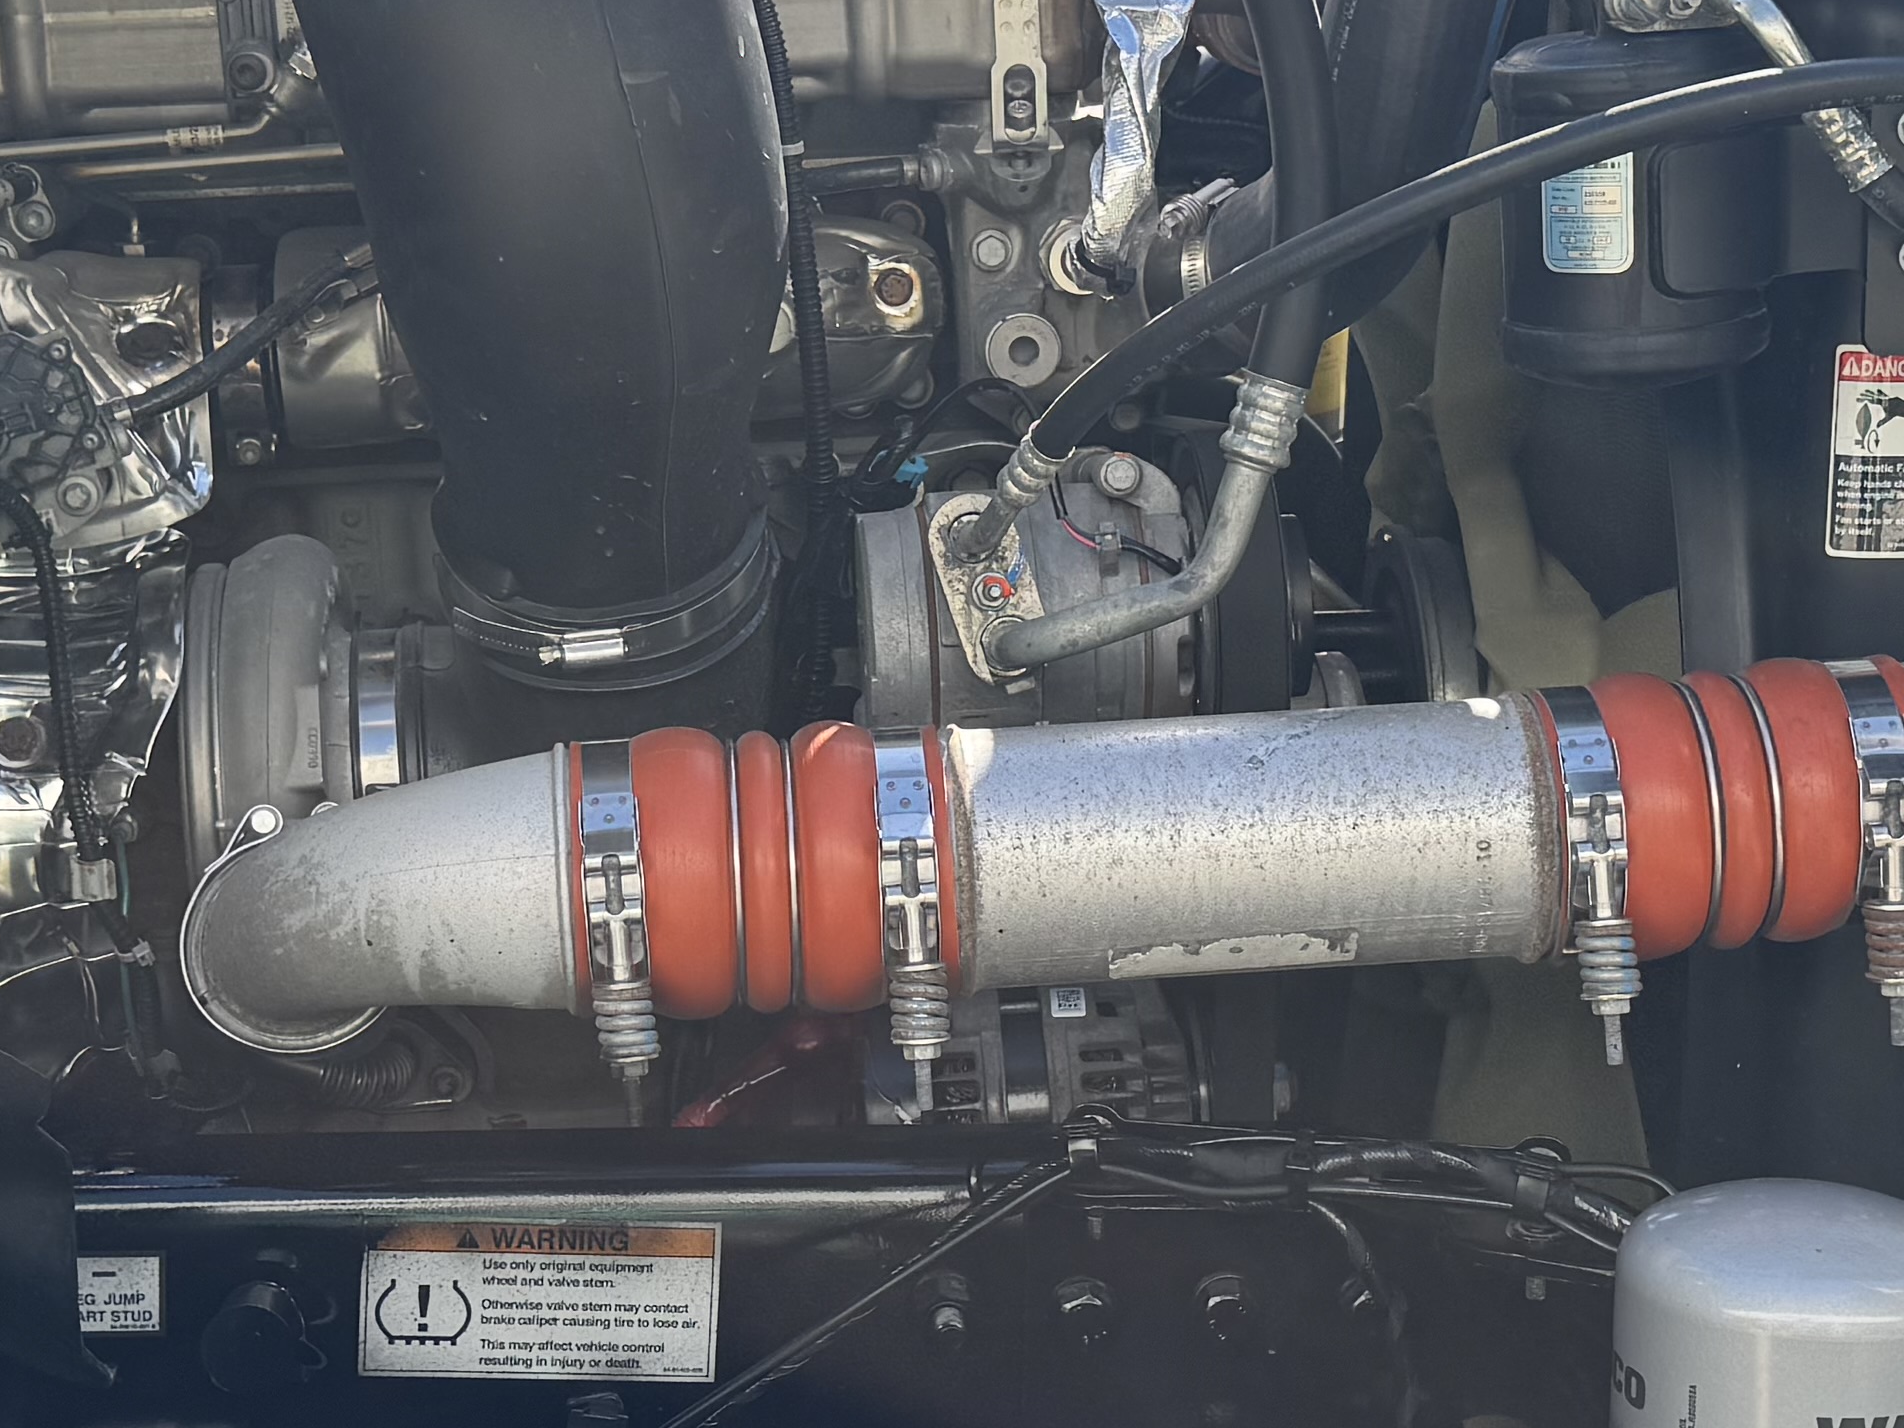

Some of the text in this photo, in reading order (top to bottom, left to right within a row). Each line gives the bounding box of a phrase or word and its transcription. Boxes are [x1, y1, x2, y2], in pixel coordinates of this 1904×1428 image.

[1838, 462, 1894, 473] Automatic
[1837, 479, 1862, 490] Keep
[1836, 515, 1852, 524] Fan
[492, 1228, 630, 1251] WARNING
[482, 1259, 654, 1276] Use only original equipment
[482, 1275, 517, 1287] wheel
[520, 1275, 544, 1288] and
[547, 1276, 580, 1288] valve
[78, 1292, 145, 1305] EG JUMP
[481, 1299, 689, 1316] Otherwise valve stem may contact
[79, 1310, 152, 1322] ART STUD
[480, 1314, 701, 1331] brake caliper causing tire to lose air.
[480, 1339, 665, 1354] This may affect vehicle control
[479, 1356, 642, 1371] resulting in injury or death.
